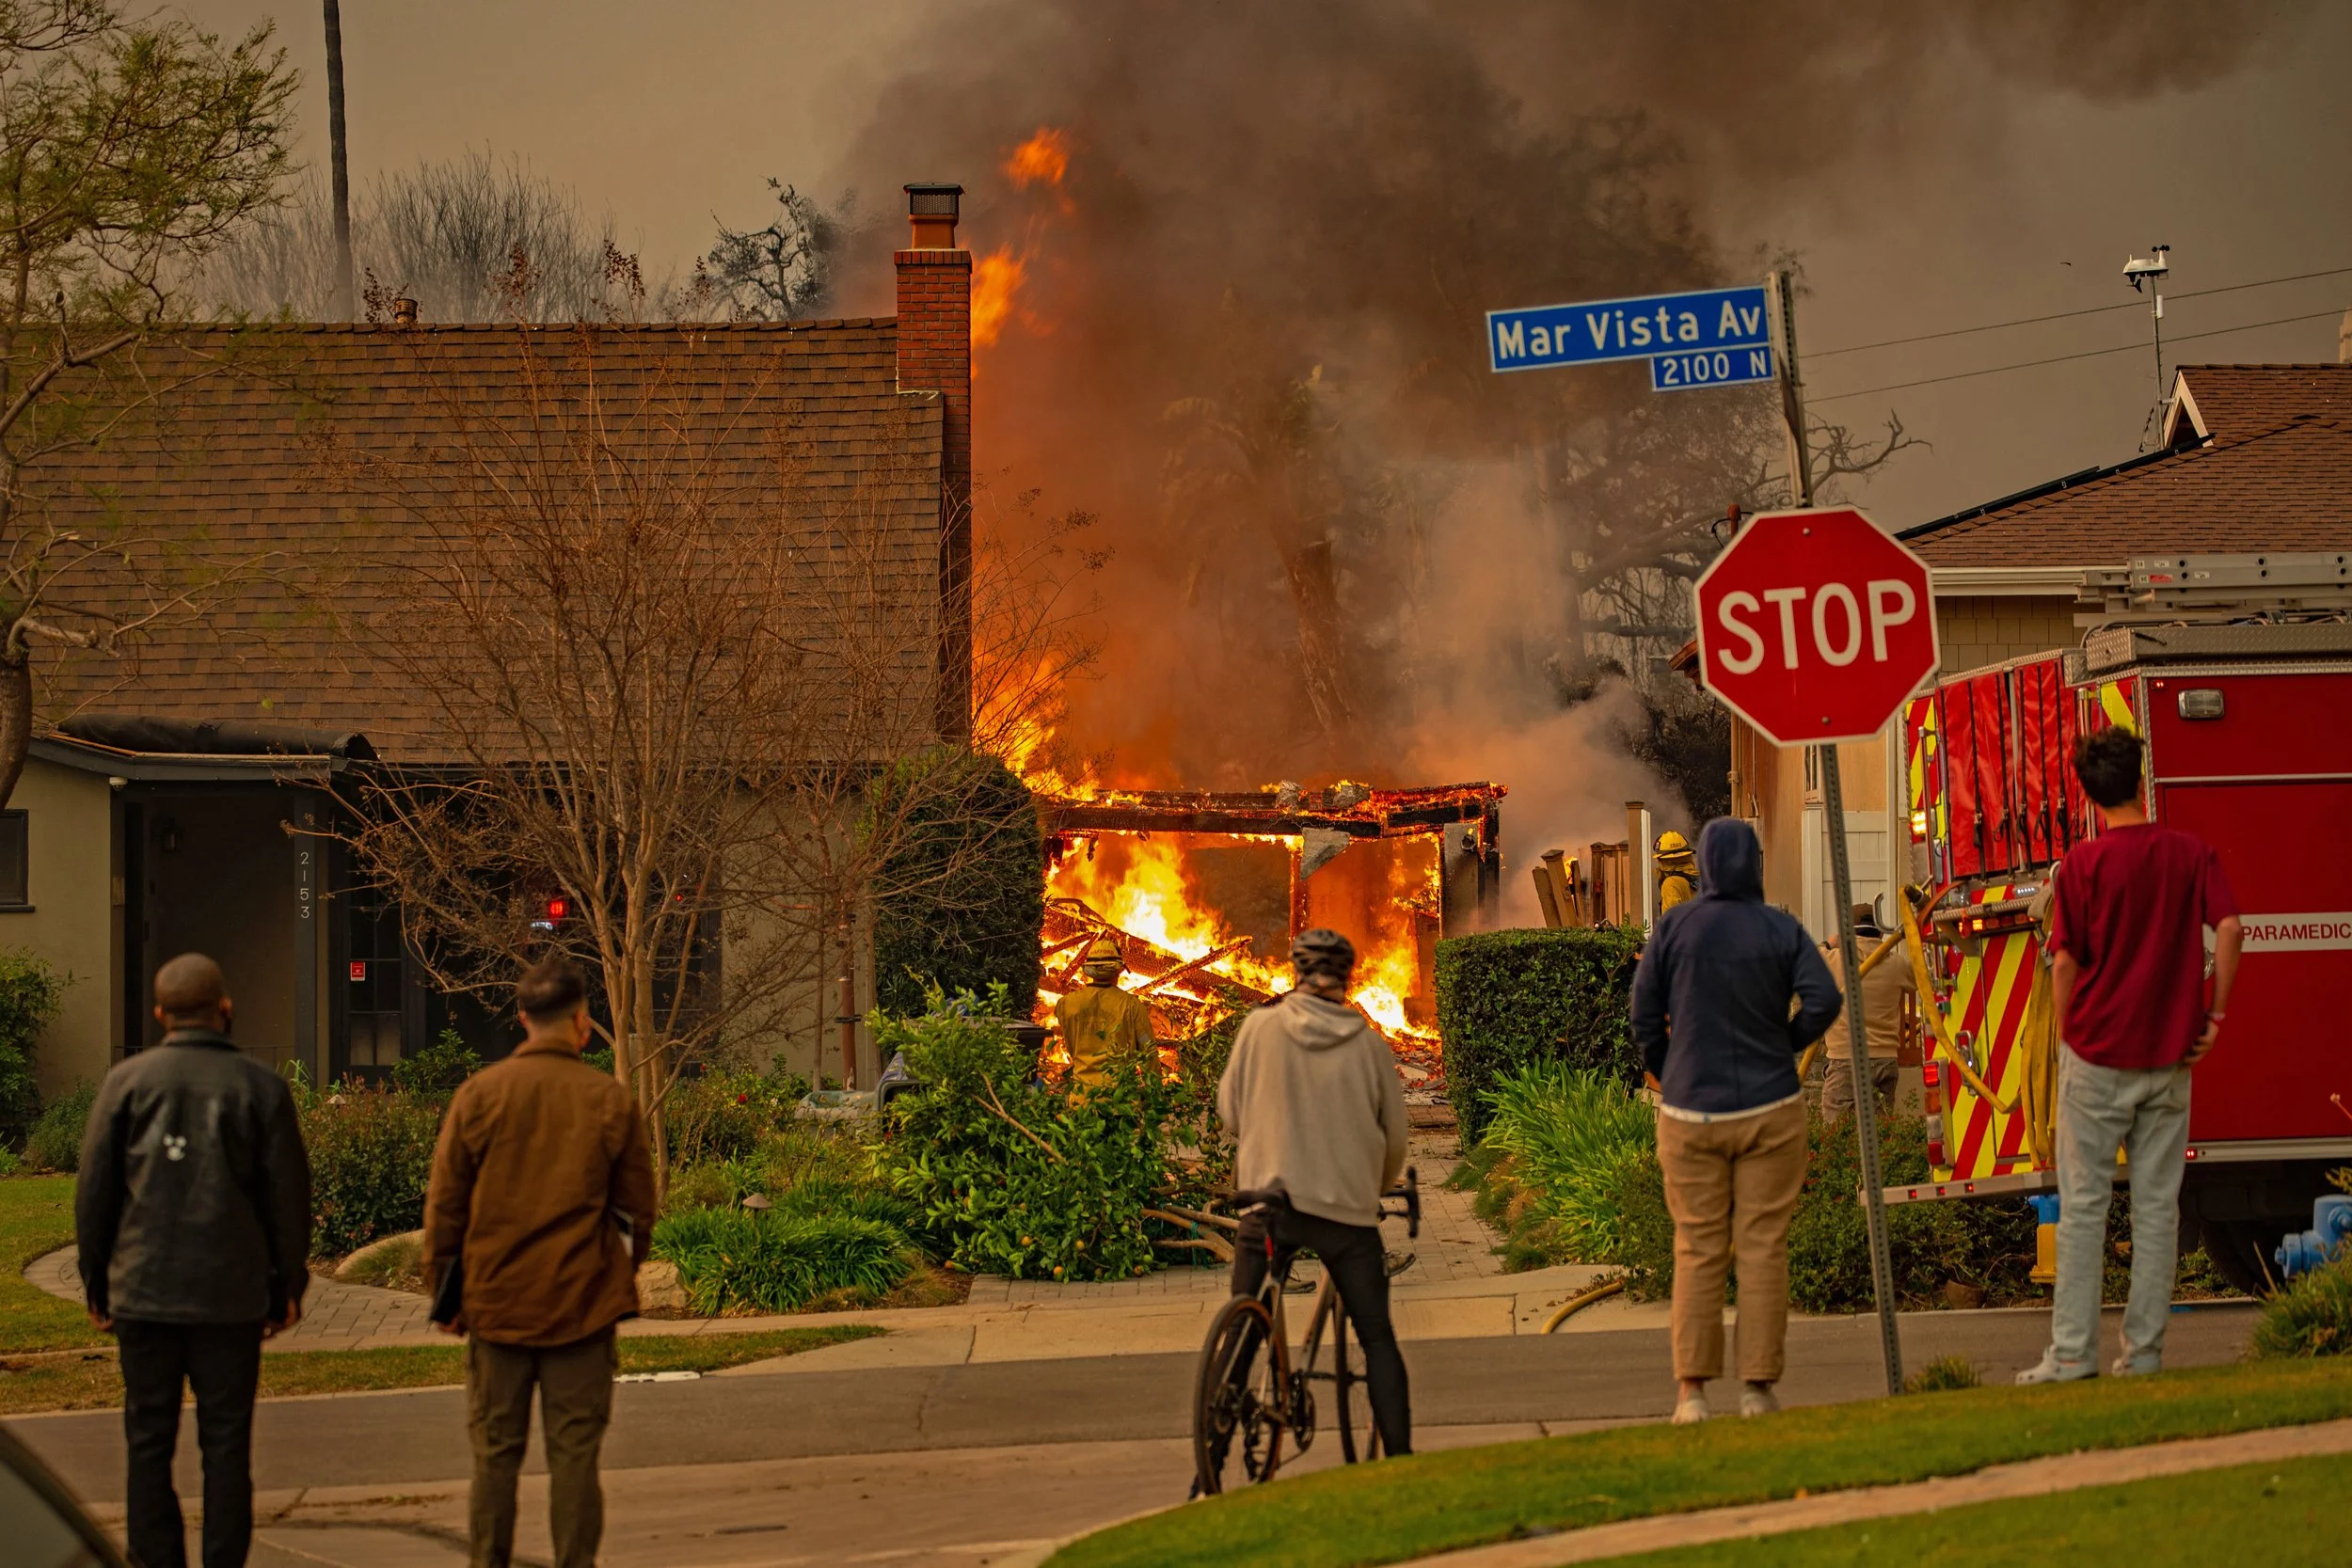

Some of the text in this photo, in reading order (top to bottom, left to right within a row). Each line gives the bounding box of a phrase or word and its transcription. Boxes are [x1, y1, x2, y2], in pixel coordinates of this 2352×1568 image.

[1496, 299, 1761, 360] Mar Vista Av
[1662, 351, 1768, 386] 2100 N
[1718, 578, 1916, 675] STOP
[299, 851, 310, 919] 2153
